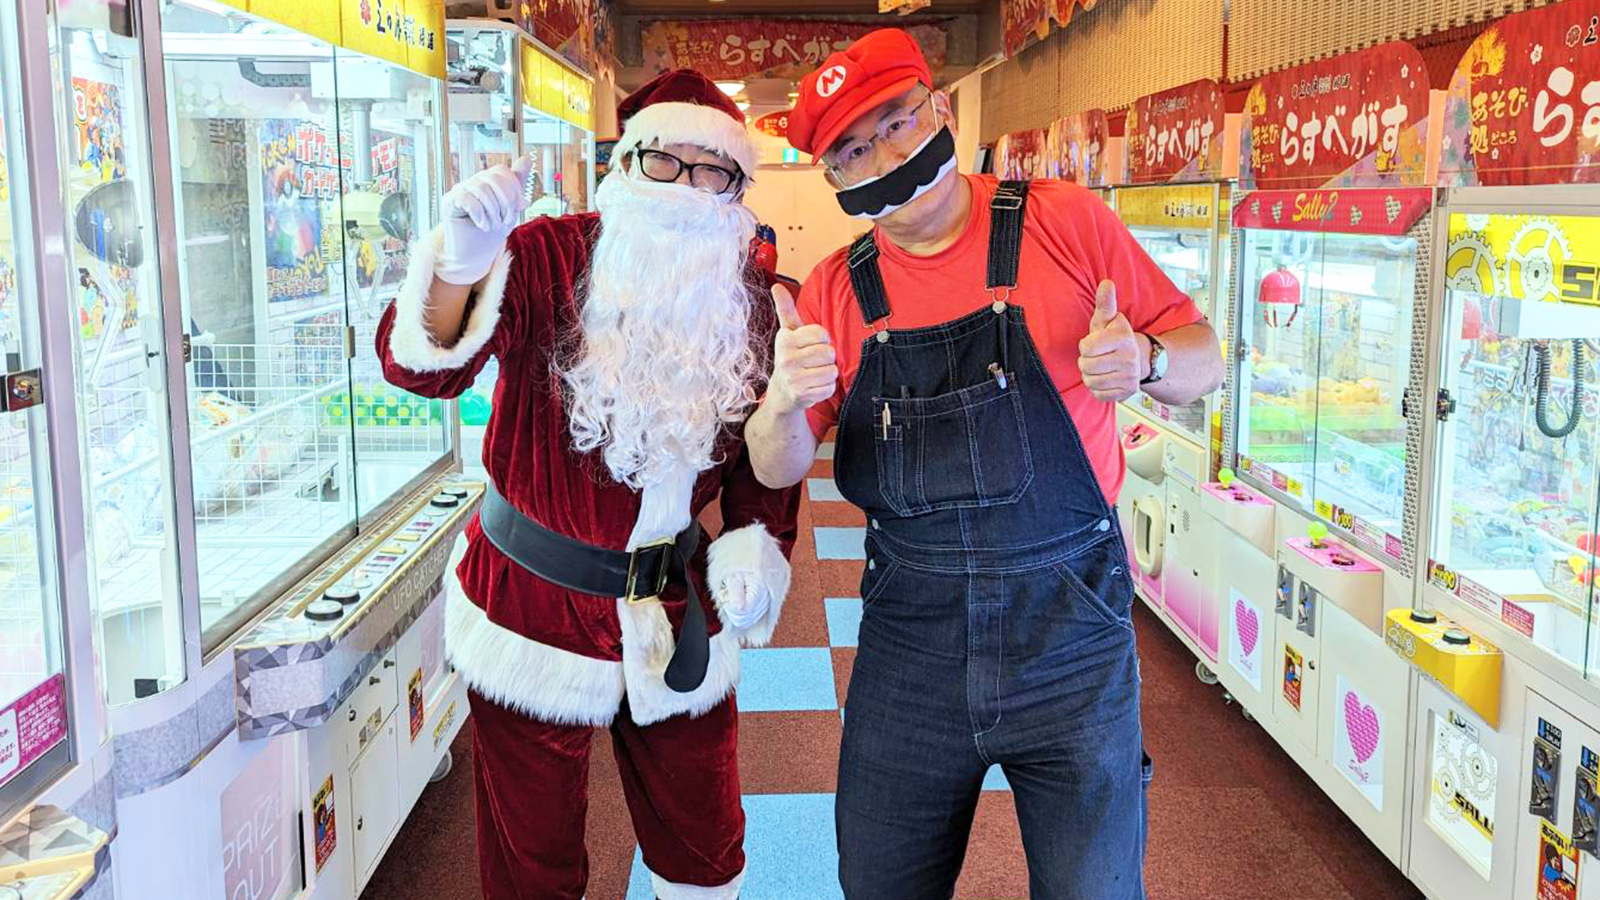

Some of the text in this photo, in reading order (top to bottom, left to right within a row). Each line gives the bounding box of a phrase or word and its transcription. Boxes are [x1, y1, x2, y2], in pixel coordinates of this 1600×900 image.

[820, 68, 844, 94] M
[1472, 87, 1529, 122] あそび
[1145, 114, 1215, 167] らすべがす
[1252, 123, 1280, 147] あそび
[1280, 94, 1409, 167] らすべがす
[1292, 190, 1339, 227] Sally2
